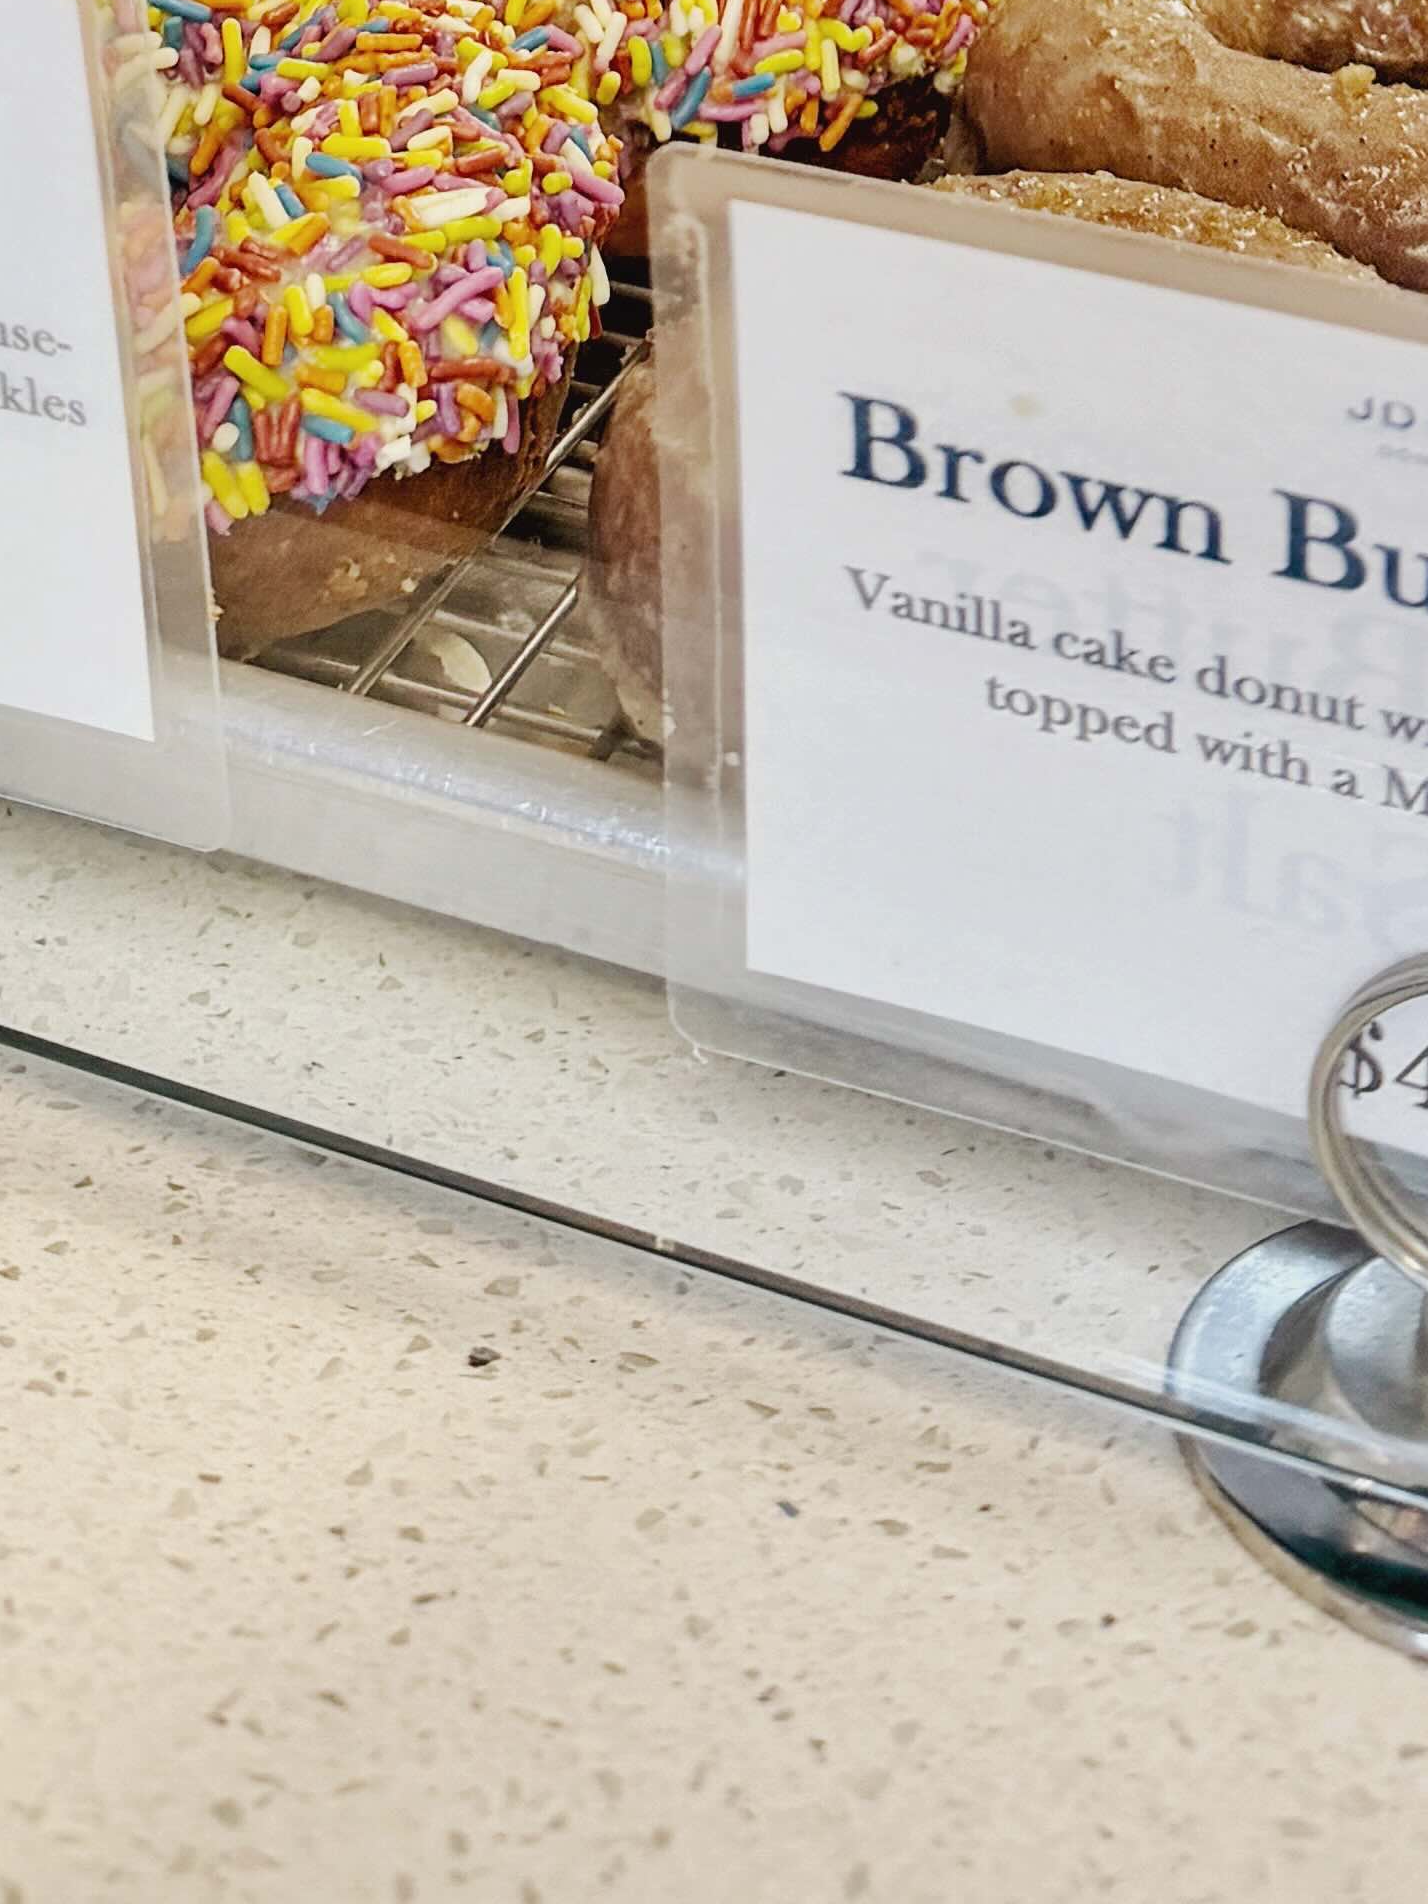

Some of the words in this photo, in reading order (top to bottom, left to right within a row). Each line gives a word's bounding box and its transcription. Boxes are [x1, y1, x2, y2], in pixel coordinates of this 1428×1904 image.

[836, 390, 1234, 566] Brown
[1346, 396, 1417, 431] JD
[842, 565, 1038, 652] Vanilla
[1052, 628, 1179, 685] cake
[1195, 655, 1369, 731] donut
[982, 674, 1179, 755] topped
[1194, 728, 1313, 789] with
[1329, 763, 1364, 800] a
